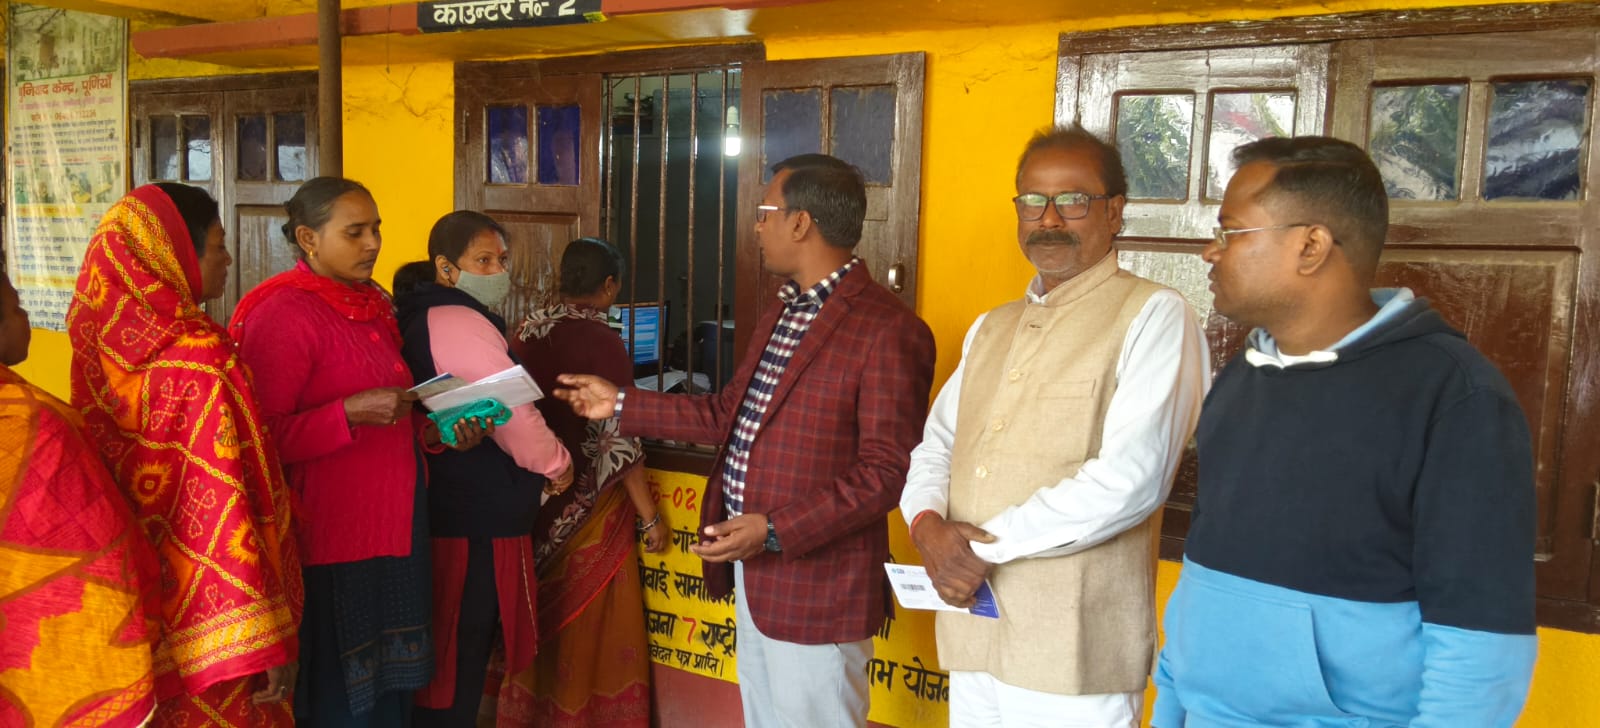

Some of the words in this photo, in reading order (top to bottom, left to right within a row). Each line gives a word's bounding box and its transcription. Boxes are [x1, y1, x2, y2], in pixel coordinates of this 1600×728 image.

[433, 1, 515, 24] काउन्टर
[558, 0, 576, 16] 2
[648, 640, 673, 664] वेदन
[675, 648, 692, 667] पत्र
[682, 616, 697, 645] 7
[700, 617, 737, 658] राष्ट्री
[866, 658, 898, 693] ाभ
